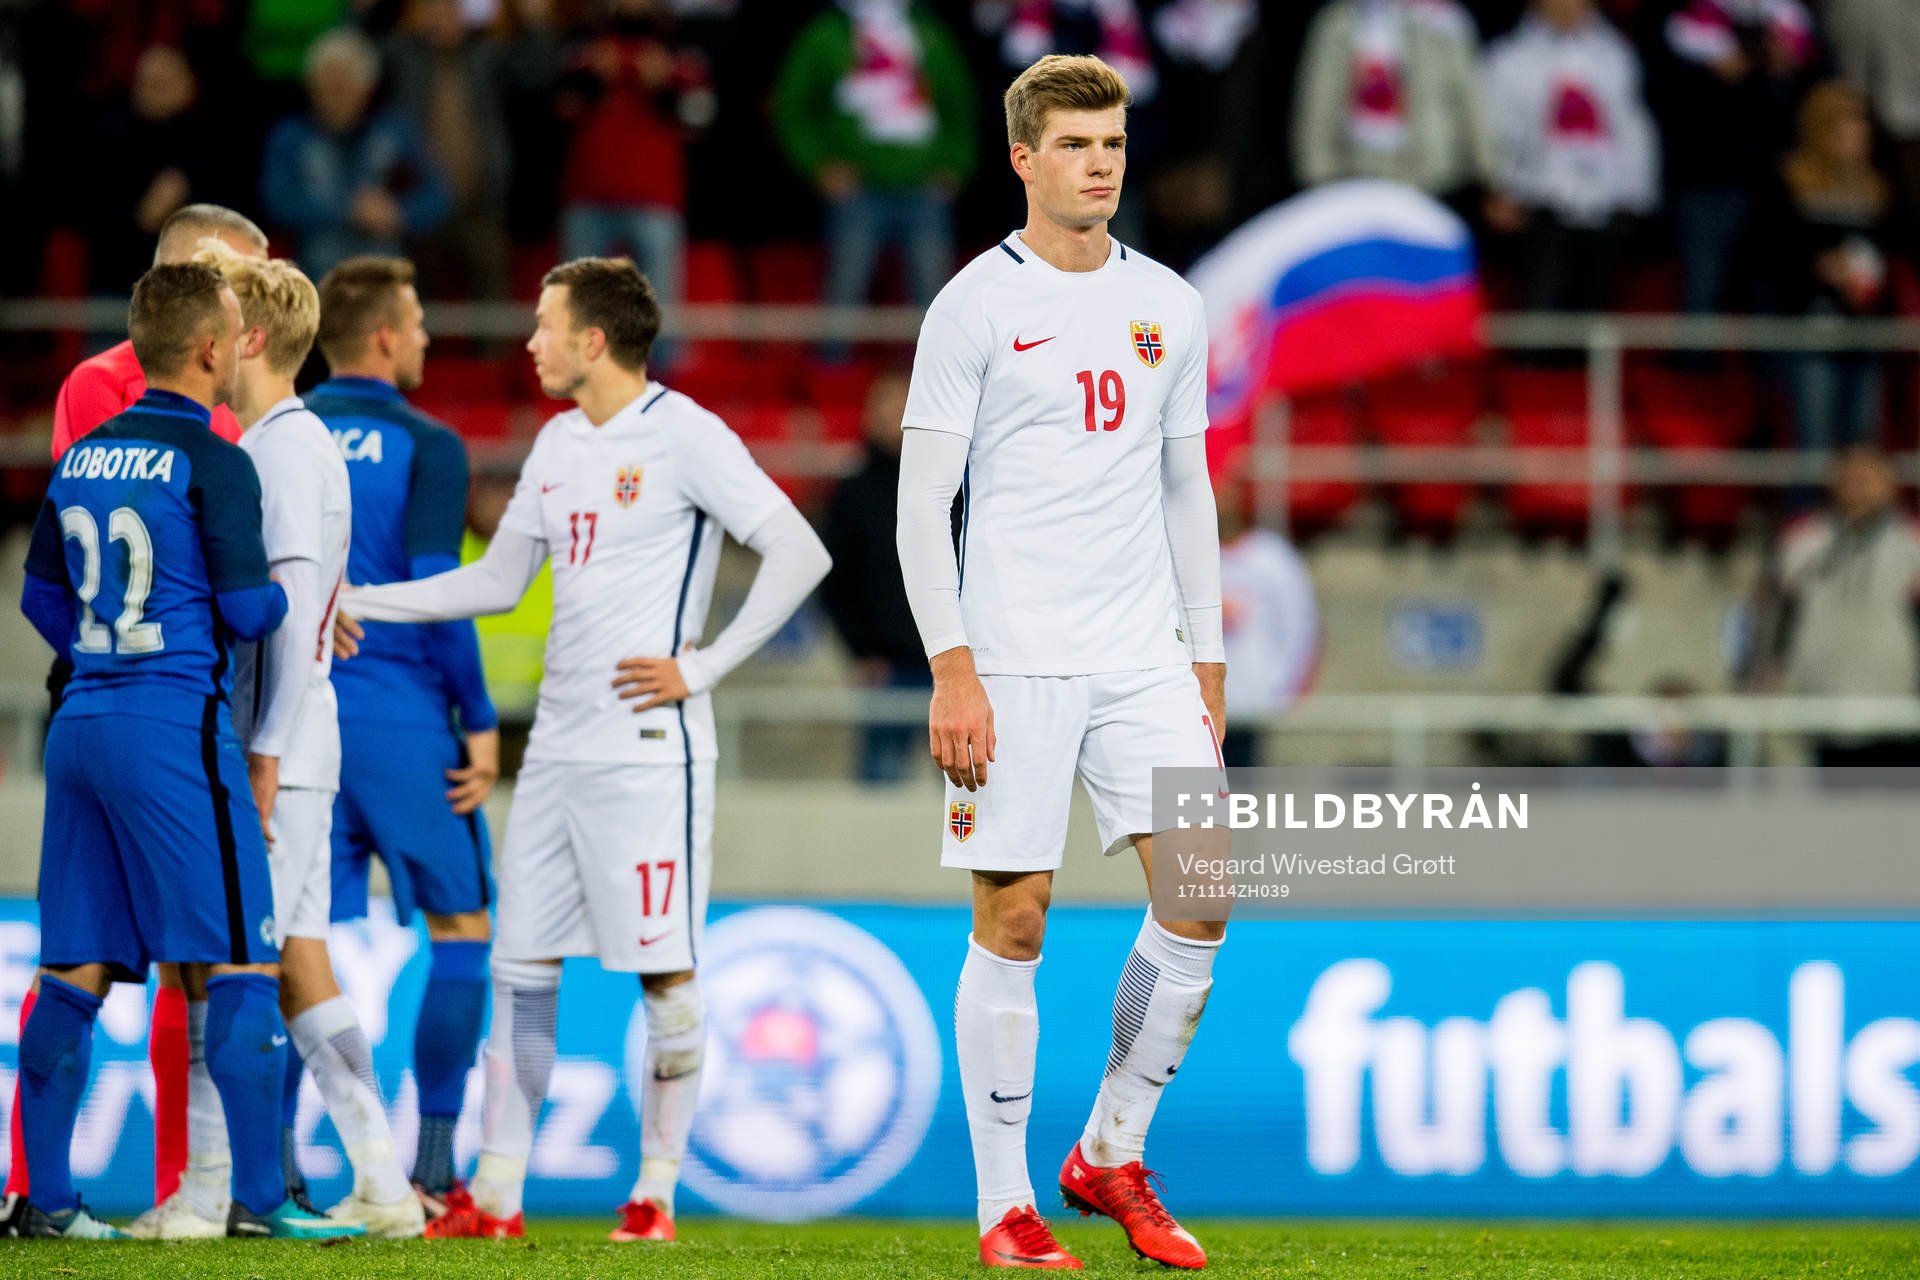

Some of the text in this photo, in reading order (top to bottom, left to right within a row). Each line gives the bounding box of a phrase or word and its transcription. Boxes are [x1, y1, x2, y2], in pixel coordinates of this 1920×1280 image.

[1076, 369, 1125, 432] 19
[61, 446, 175, 483] LOBOTKA
[570, 512, 598, 566] 17
[60, 505, 165, 654] 22
[636, 861, 675, 916] 17
[1289, 959, 1920, 1177] futbals
